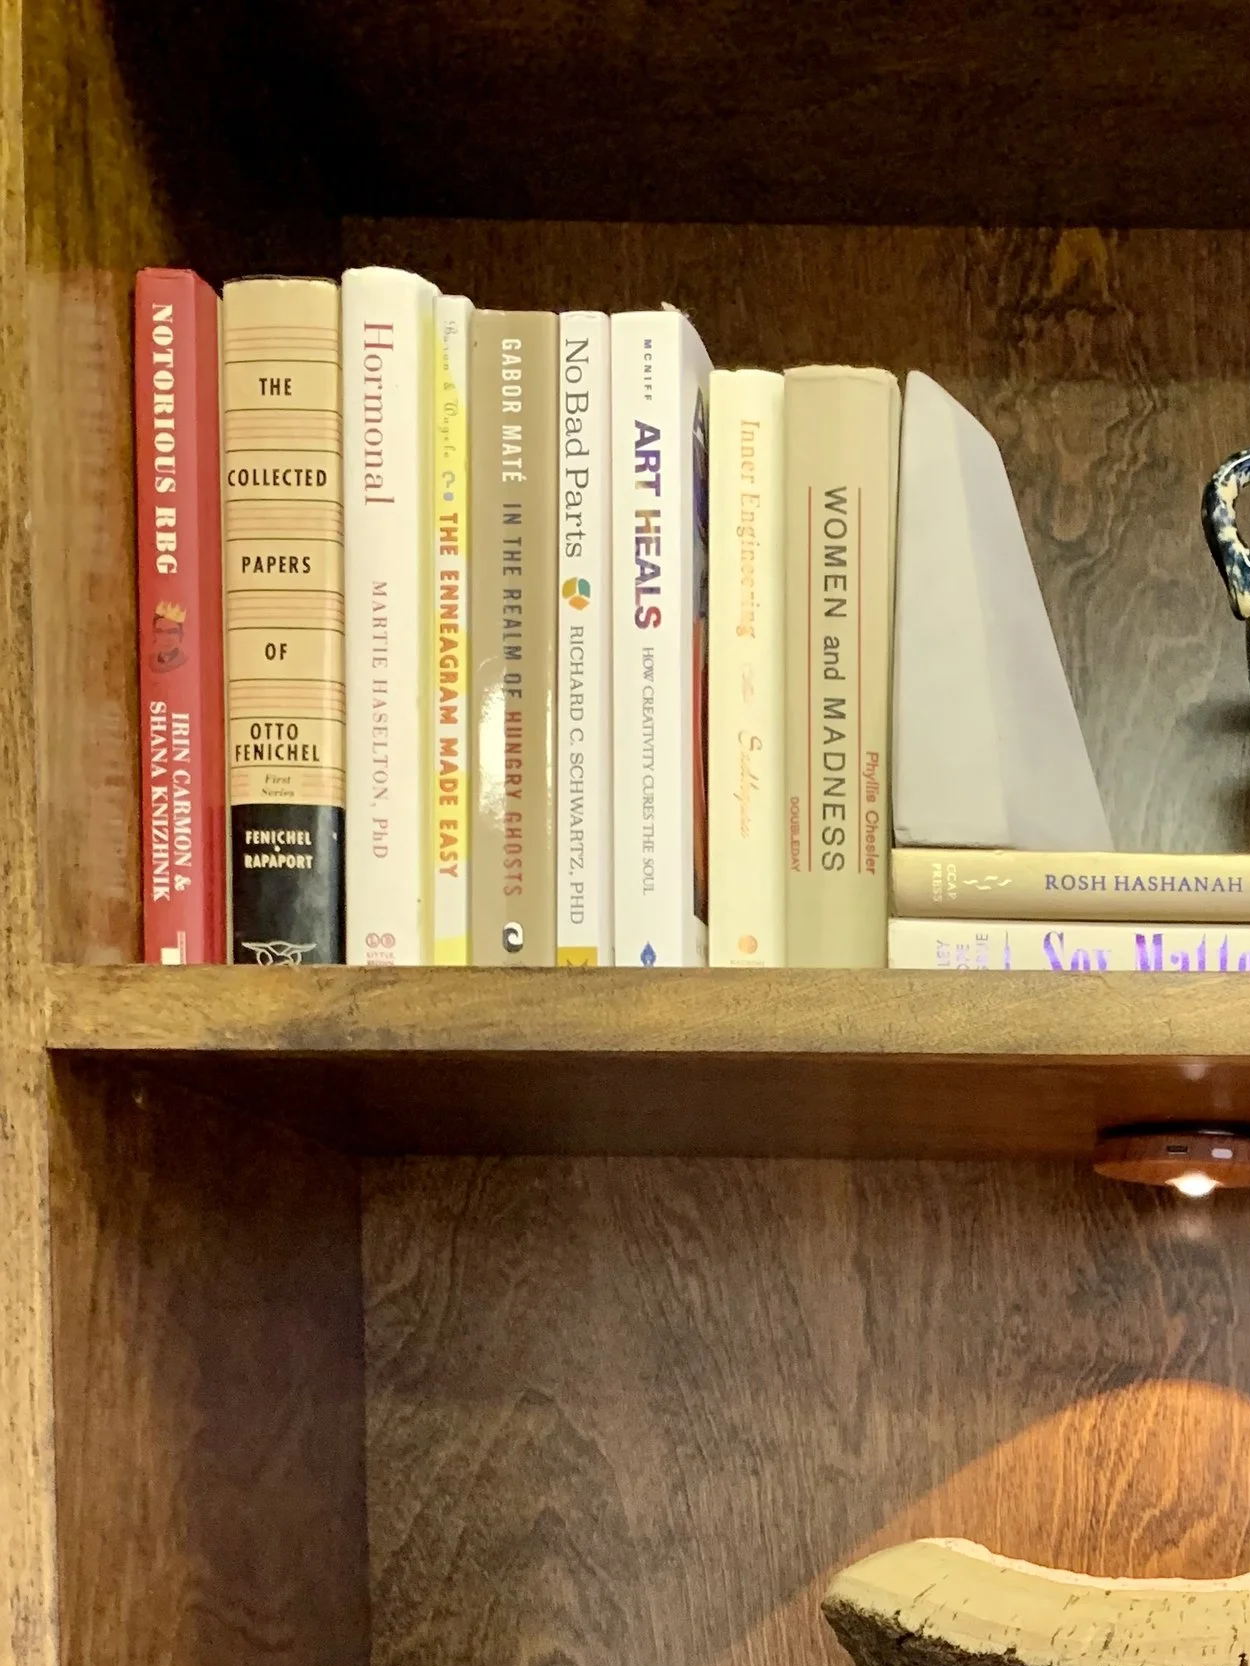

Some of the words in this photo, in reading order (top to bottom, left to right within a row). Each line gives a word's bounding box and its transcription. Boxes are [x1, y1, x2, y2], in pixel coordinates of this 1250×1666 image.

[259, 377, 292, 397] THE
[501, 339, 523, 413] GABOR
[564, 338, 590, 383] No
[643, 339, 653, 402] MCNIFF
[153, 304, 177, 492] NOTORIOUS
[363, 321, 395, 506] Hormonal
[563, 390, 590, 459] Bad
[228, 468, 327, 488] COLLECTED
[501, 425, 526, 482] MATÉ
[634, 420, 661, 497] ART
[740, 420, 760, 484] Inner
[155, 507, 178, 574] RBG
[441, 513, 457, 555] THE
[502, 503, 522, 524] IN
[563, 468, 590, 558] Parts
[242, 555, 311, 575] PAPERS
[502, 535, 522, 577] THE
[634, 509, 662, 630] HEALS
[737, 492, 761, 639] Engineering
[823, 486, 847, 618] WOMEN
[265, 643, 287, 661] OF
[371, 582, 387, 668] MARTIE
[439, 570, 459, 725] ENNEAGRAM
[502, 588, 523, 661] REALM
[502, 673, 523, 698] OF
[569, 625, 586, 720] RICHARD
[641, 647, 655, 681] HOW
[823, 636, 847, 680] and
[150, 701, 169, 777] SHANA
[171, 713, 190, 761] IRIN
[235, 742, 320, 762] FENICHEL
[250, 723, 299, 742] OTTO
[371, 679, 388, 807] HASELTON,
[502, 711, 523, 799] HUNGRY
[569, 728, 586, 746] C.
[641, 685, 655, 772] CREATIVITY
[261, 786, 294, 798] Series
[263, 774, 291, 786] First
[439, 738, 458, 807] MADE
[641, 774, 655, 820] CURES
[822, 697, 847, 872] MADNESS
[863, 751, 880, 802] Phyllis
[151, 786, 171, 901] KNIZHNIK
[171, 769, 192, 867] CARMON
[245, 830, 312, 846] FENICHEL
[372, 818, 388, 859] PhD
[567, 753, 586, 876] SCHWARTZ,
[641, 823, 655, 852] THE
[790, 796, 800, 872] DOUBLEDAY
[864, 810, 879, 875] Chesler
[244, 853, 313, 870] RAPAPORT
[438, 819, 459, 878] EASY
[502, 811, 523, 897] GHOSTS
[641, 857, 655, 896] SOUL
[174, 875, 190, 890] &
[569, 882, 586, 925] PHD
[1045, 874, 1106, 891] ROSH
[1114, 876, 1243, 892] HASHANAH
